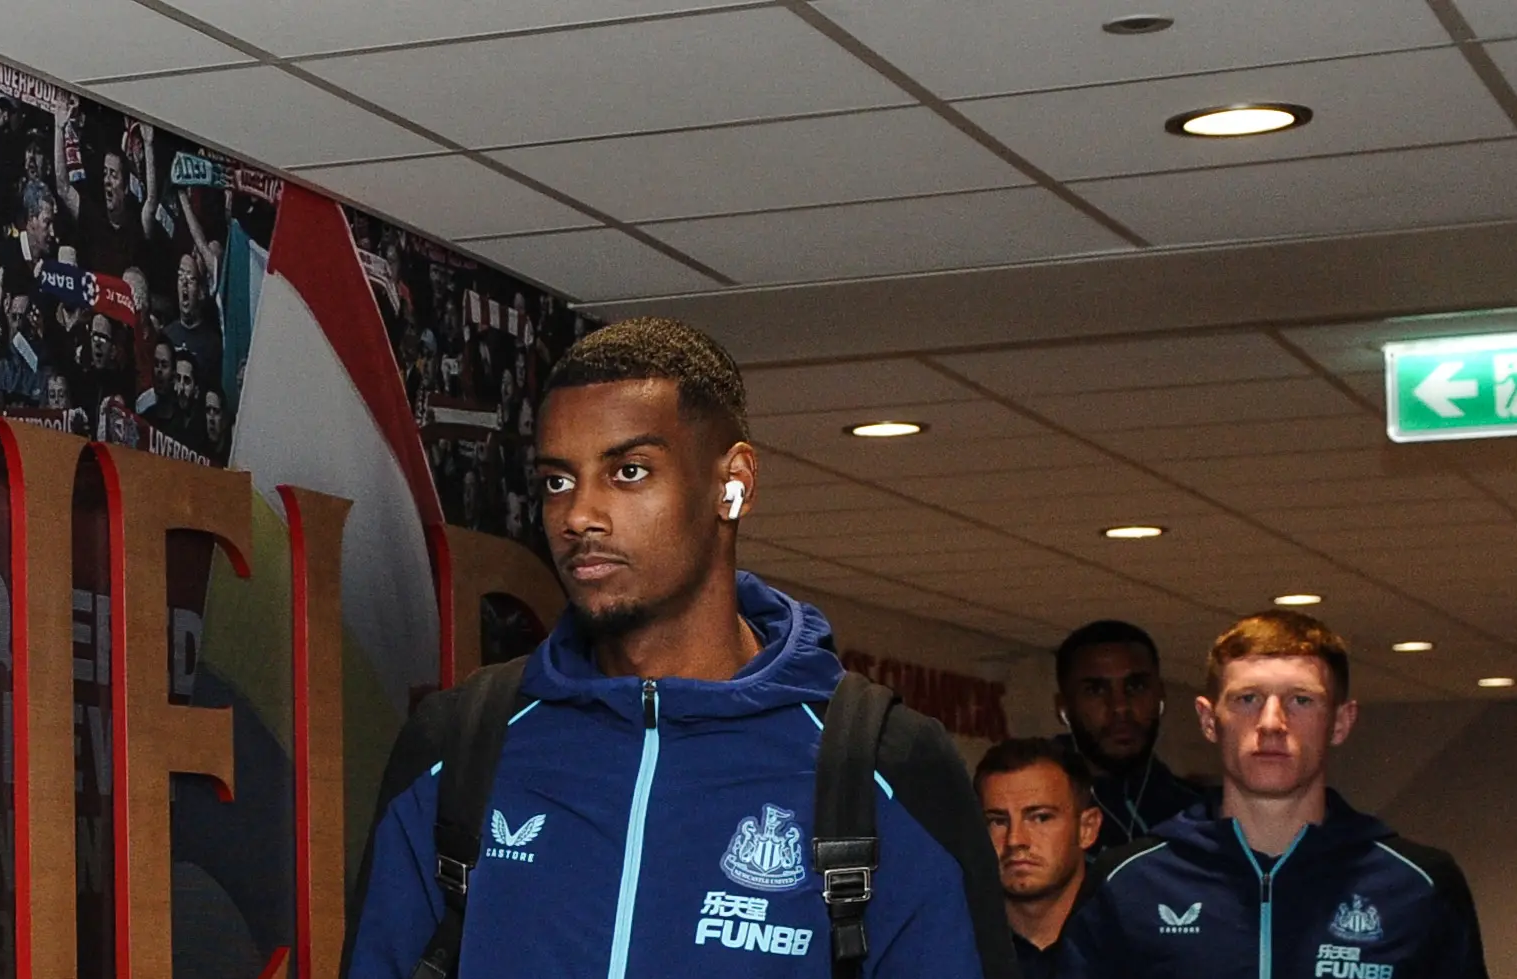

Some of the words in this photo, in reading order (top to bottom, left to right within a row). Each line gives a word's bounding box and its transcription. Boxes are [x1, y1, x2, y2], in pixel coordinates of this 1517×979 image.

[485, 847, 535, 863] CASTORE
[700, 891, 769, 922] 乐天堂
[695, 917, 813, 956] FUN88
